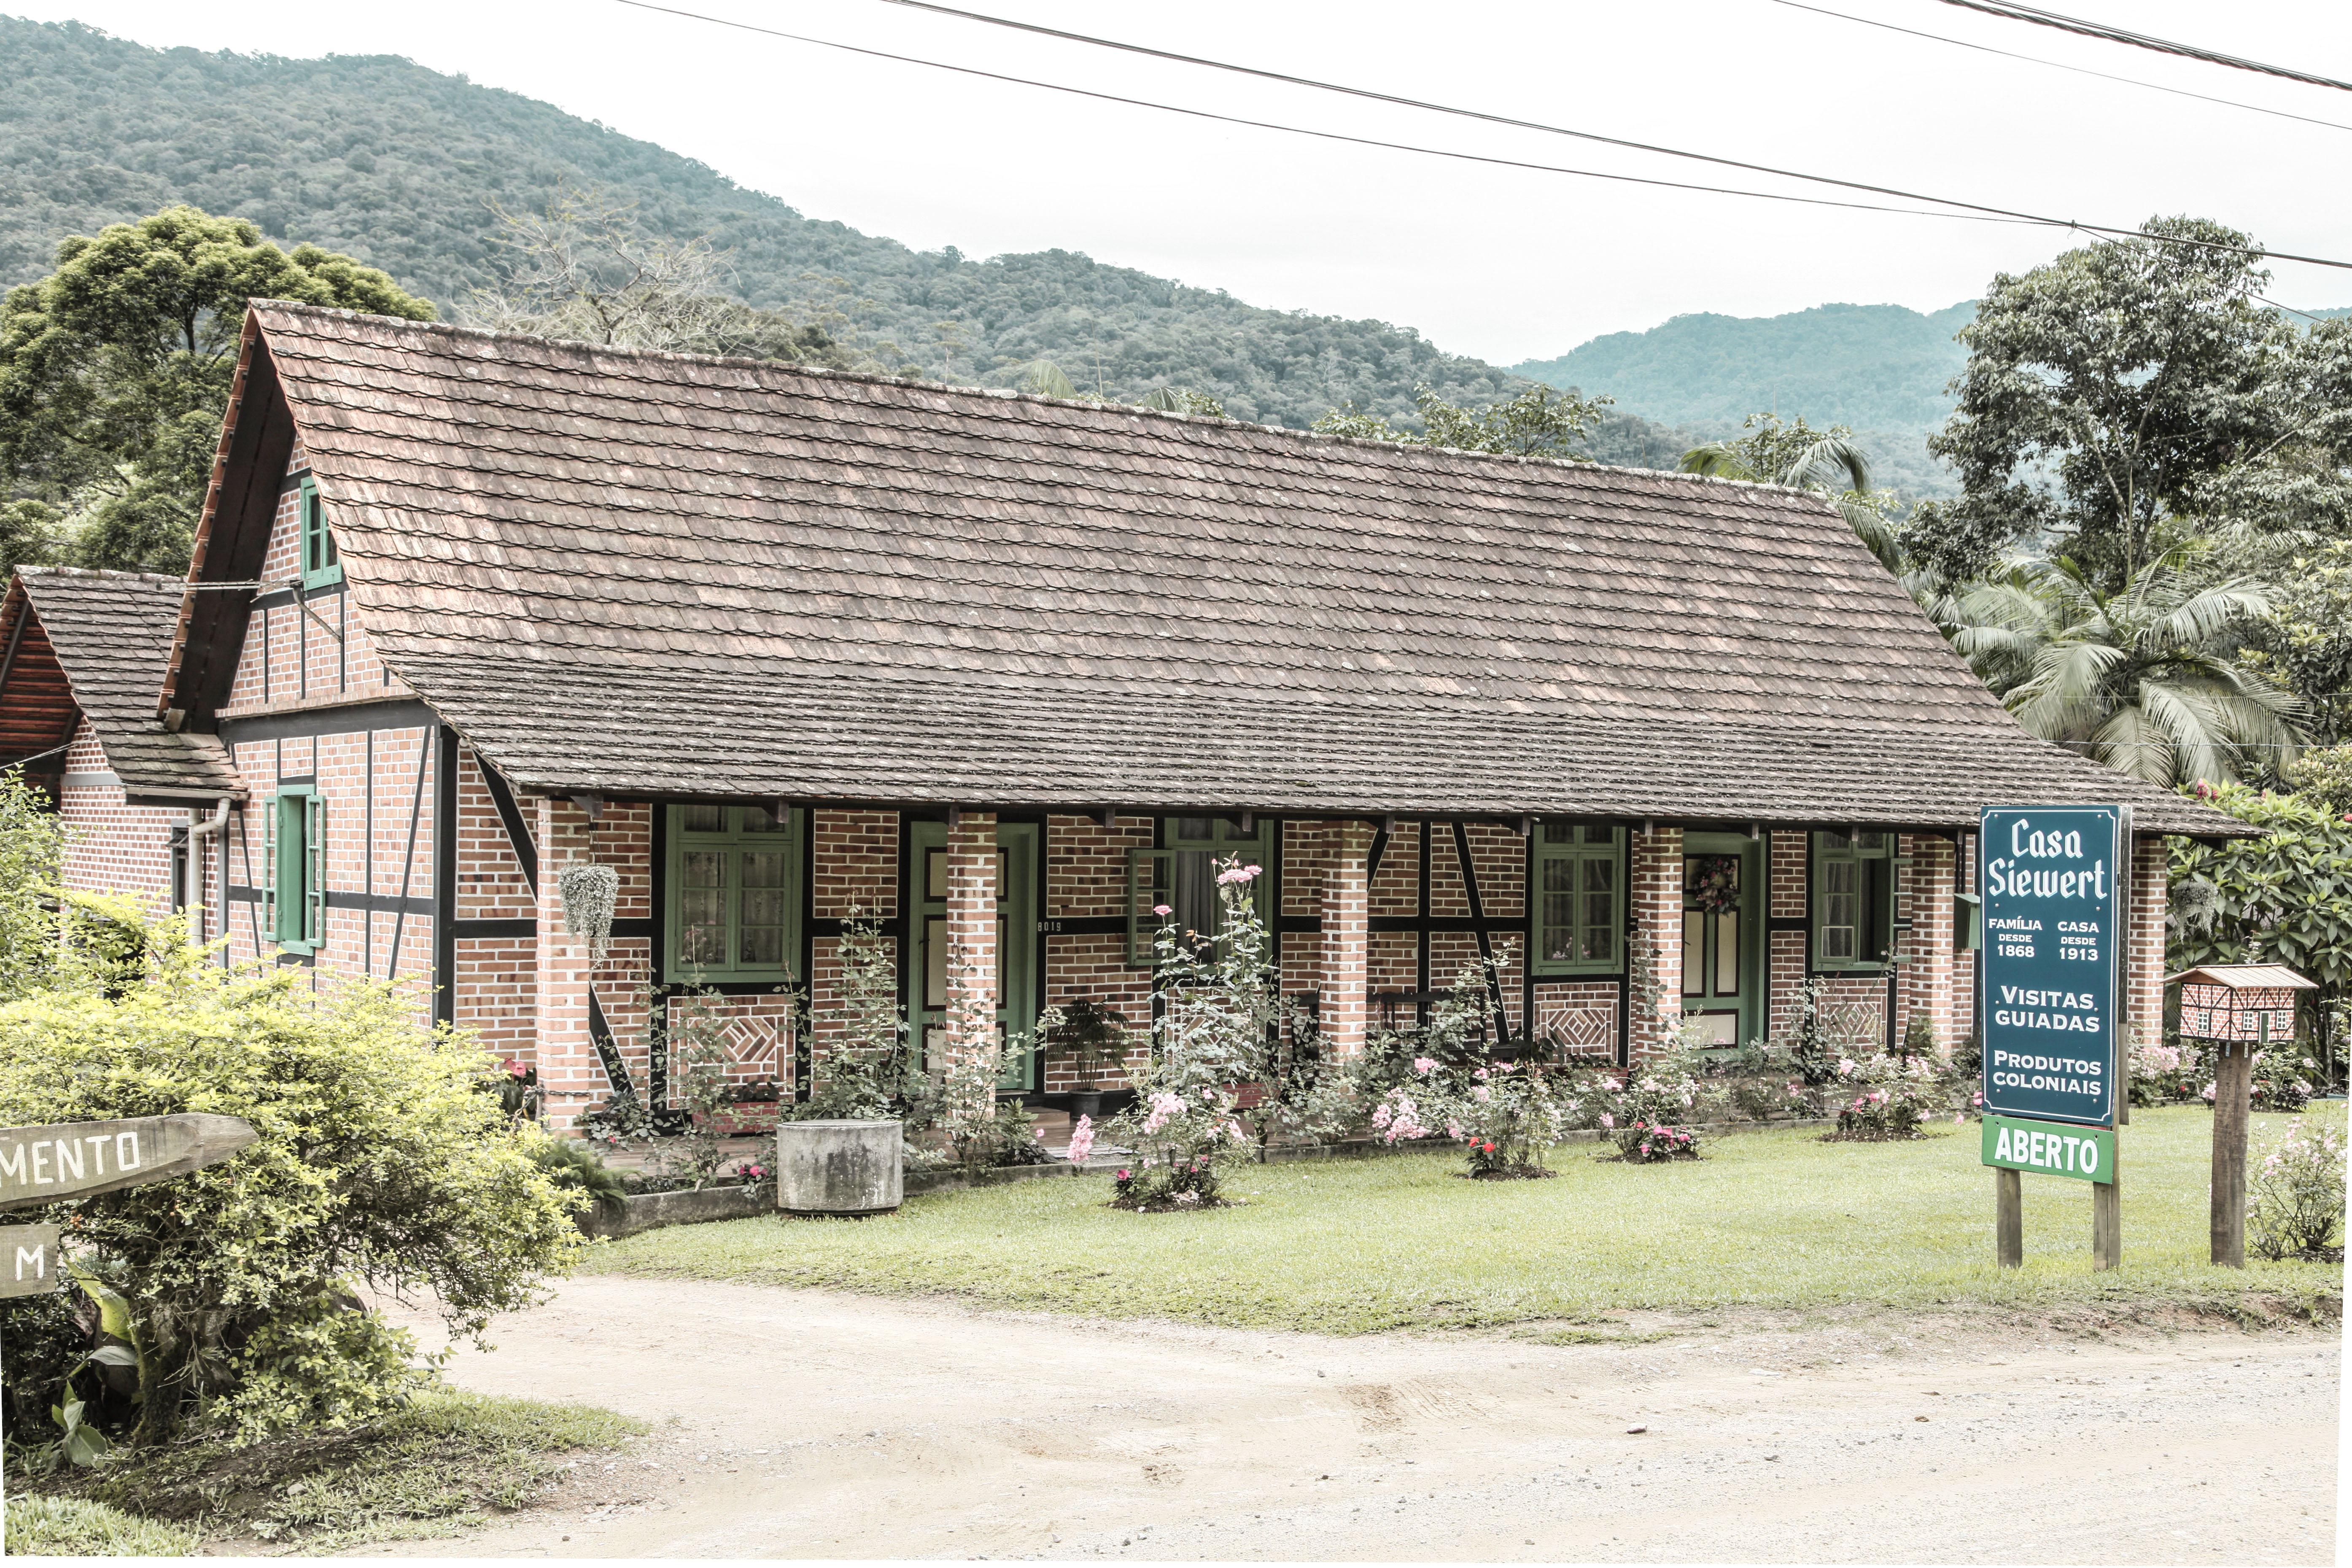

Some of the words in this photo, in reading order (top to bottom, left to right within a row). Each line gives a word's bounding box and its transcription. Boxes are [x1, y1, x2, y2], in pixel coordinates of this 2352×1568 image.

[2012, 819, 2083, 858] Casa
[1989, 858, 2107, 899] Siewert
[1038, 921, 1061, 931] 8019
[1989, 916, 2042, 930] FAMÍLIA
[2058, 921, 2099, 932] CASA
[1999, 934, 2032, 942] DESDE
[2061, 937, 2096, 946] DESDE
[1998, 945, 2035, 957] 1868
[2060, 948, 2099, 961] 1913
[2001, 986, 2094, 1009] VISITAS
[1995, 1010, 2100, 1032] GUIADAS
[1994, 1050, 2101, 1075] PRODUTOS
[1993, 1072, 2101, 1095] COLONIAIS
[1995, 1127, 2098, 1174] ABERTO
[16, 1245, 44, 1281] M
